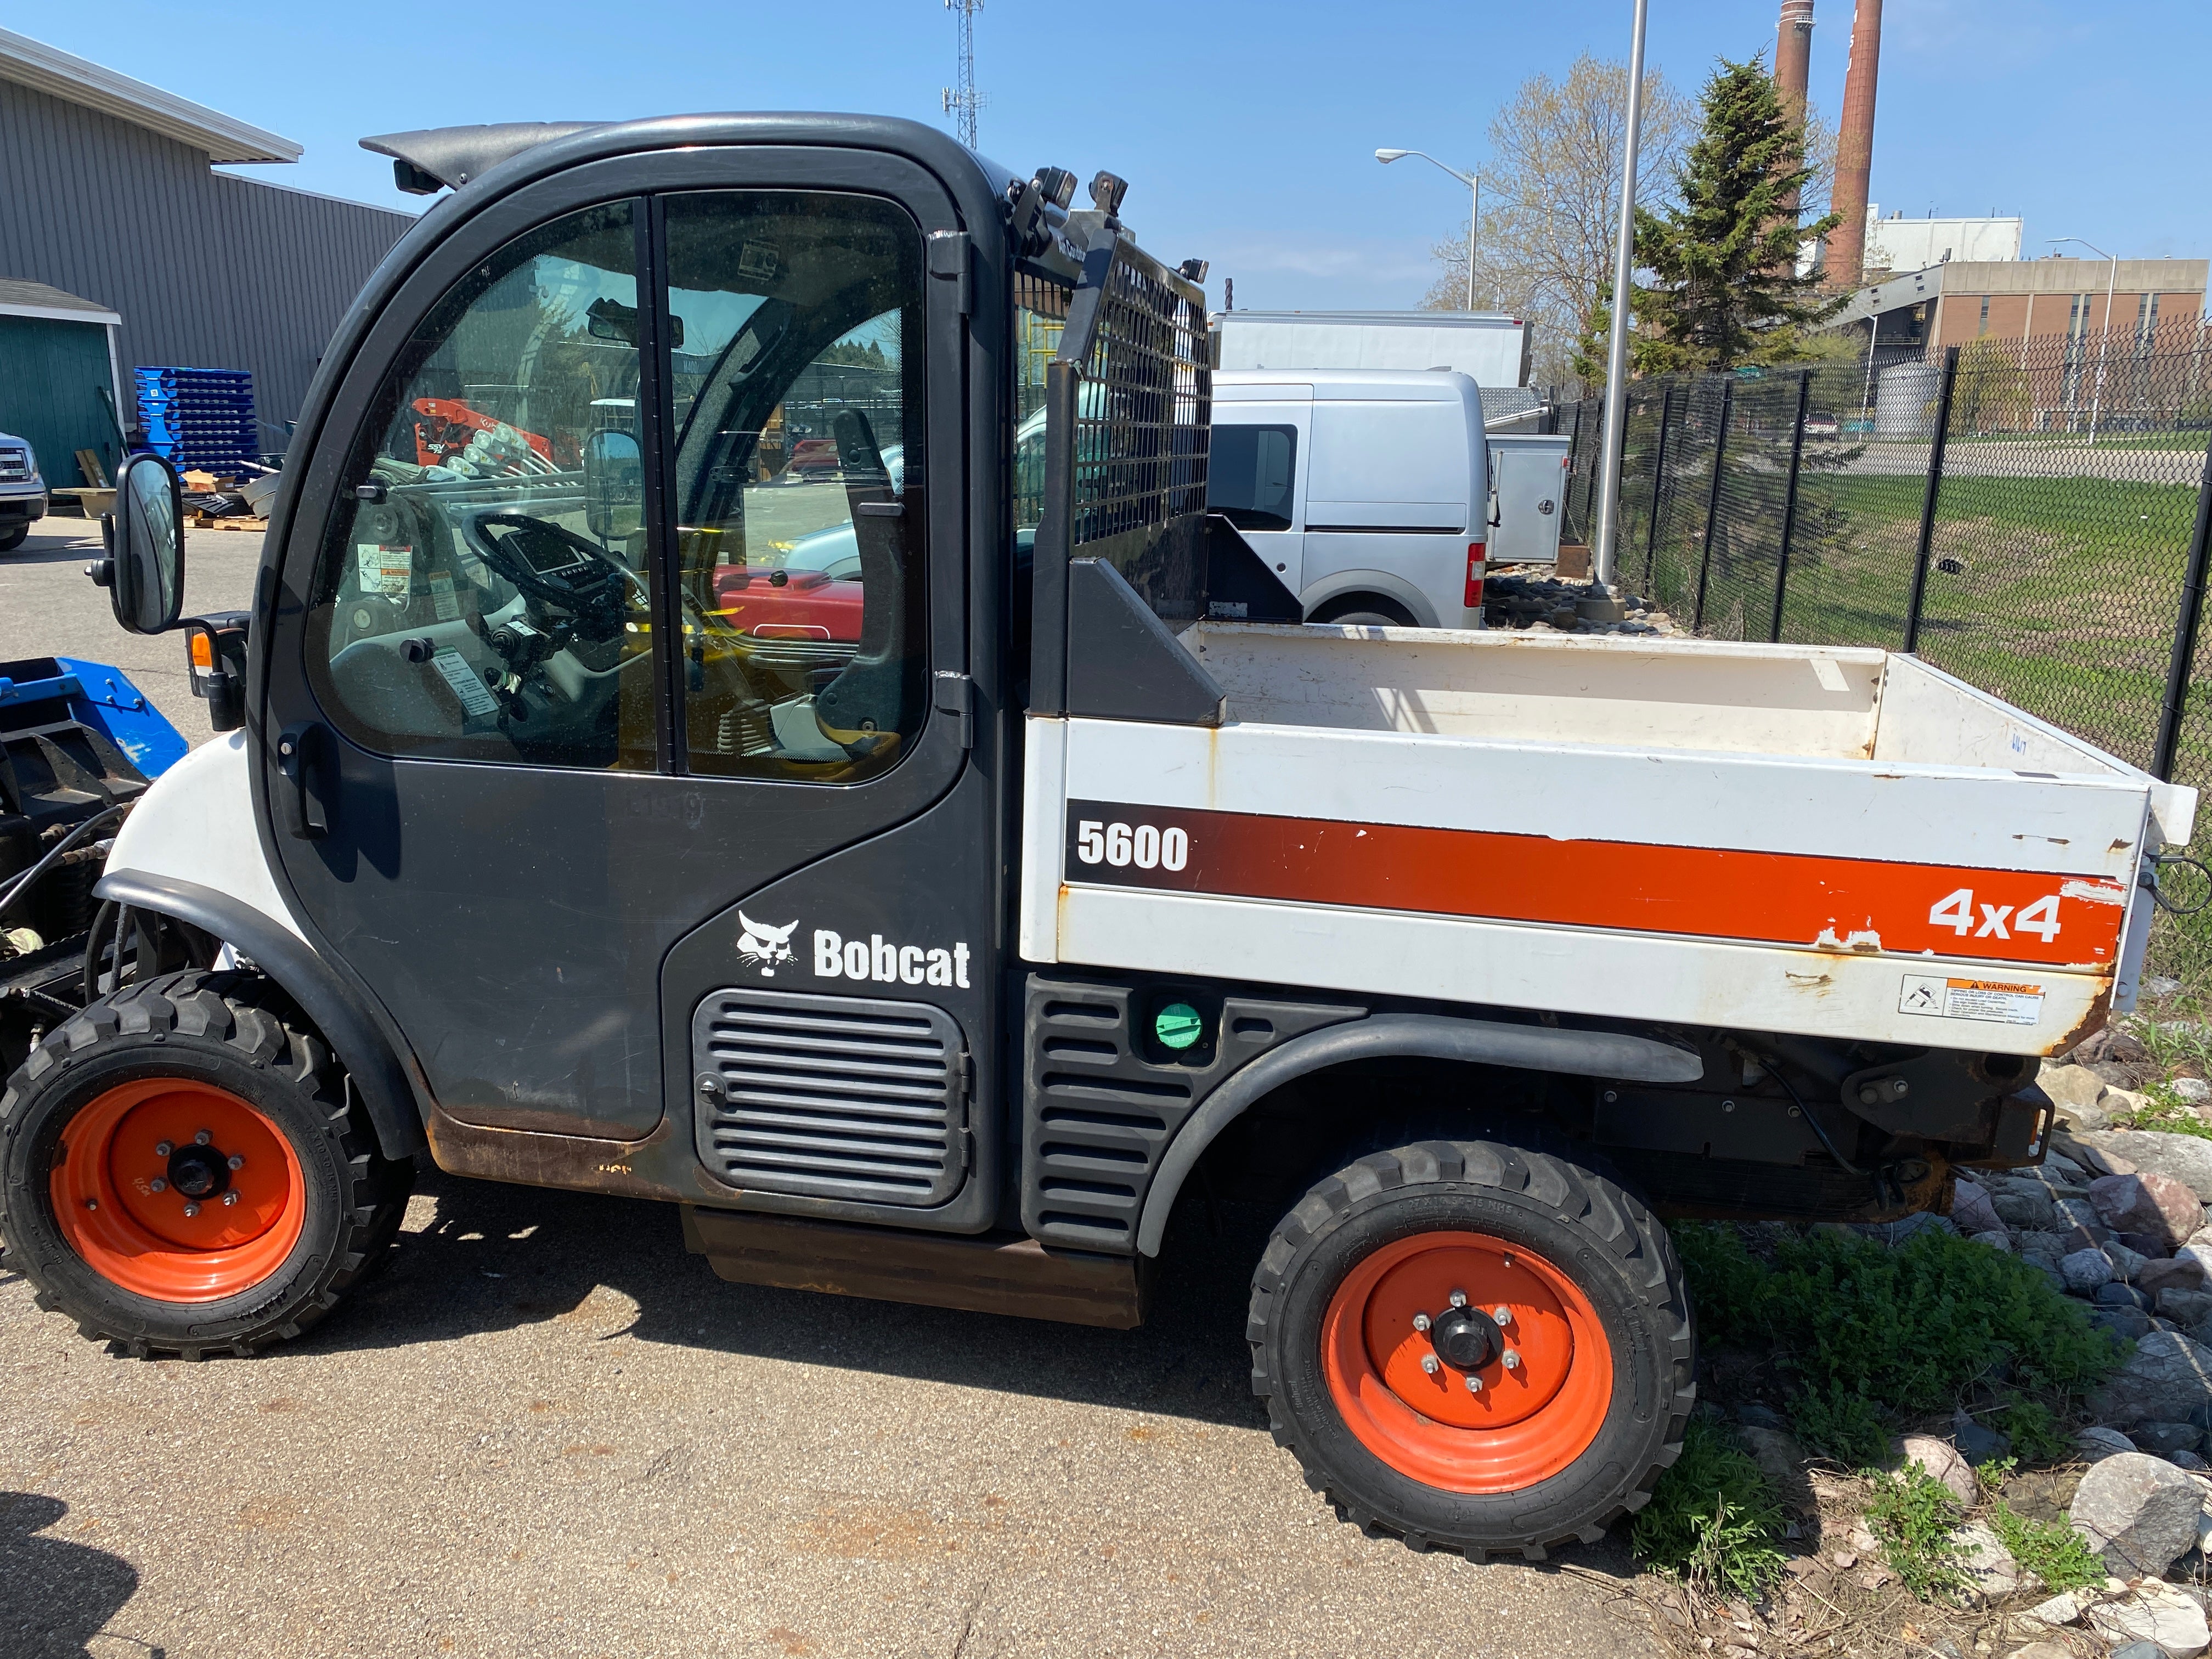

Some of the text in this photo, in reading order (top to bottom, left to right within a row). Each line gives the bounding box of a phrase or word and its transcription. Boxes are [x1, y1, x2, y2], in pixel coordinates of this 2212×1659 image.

[1078, 820, 1188, 872] 5600
[1929, 888, 2062, 943] 4x4
[813, 929, 970, 989] Bobcat
[1983, 983, 2027, 992] WARNING
[1165, 1033, 1193, 1044] DIESEL
